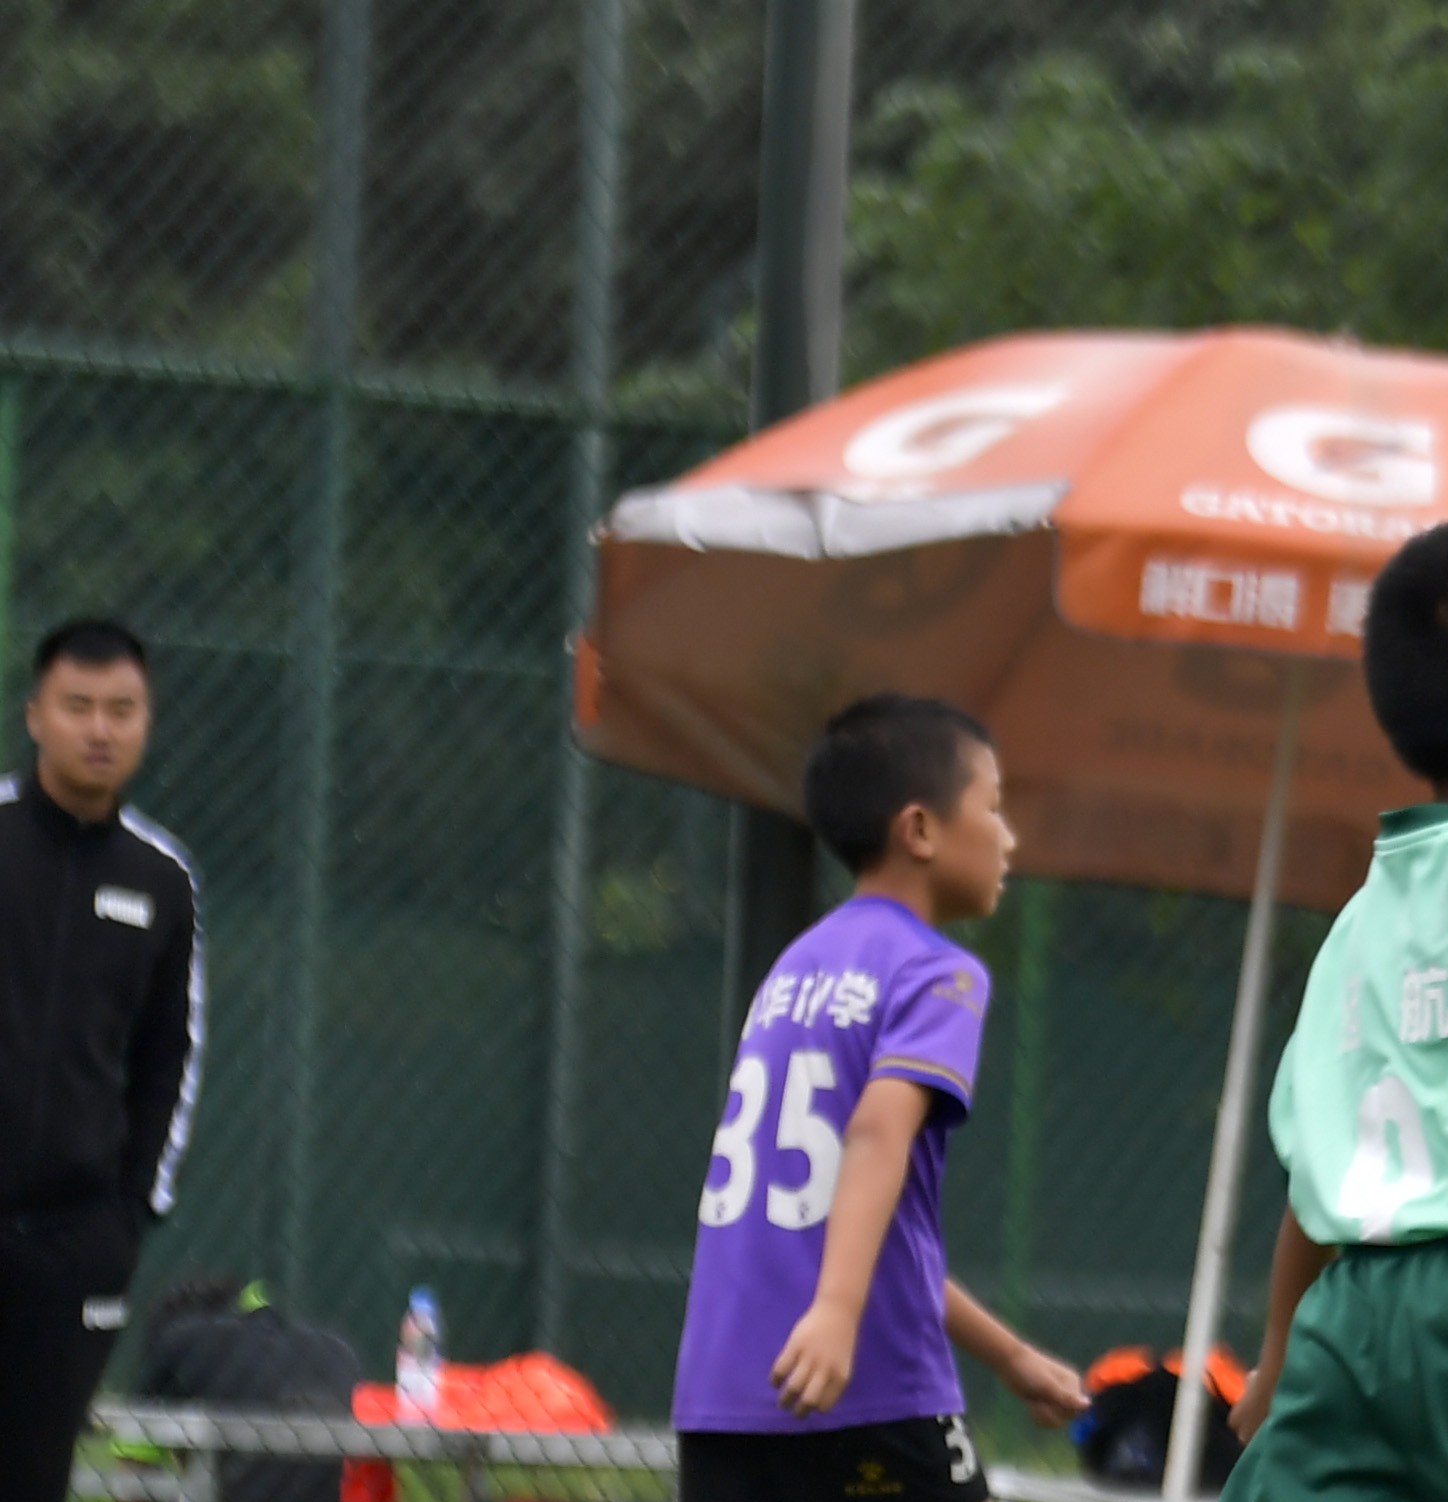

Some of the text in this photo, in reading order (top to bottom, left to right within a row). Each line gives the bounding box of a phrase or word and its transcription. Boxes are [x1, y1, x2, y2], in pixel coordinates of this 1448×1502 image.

[1244, 411, 1435, 506] G
[1179, 486, 1438, 541] GATORA
[741, 970, 879, 1041] 华小学
[698, 1051, 843, 1230] 35
